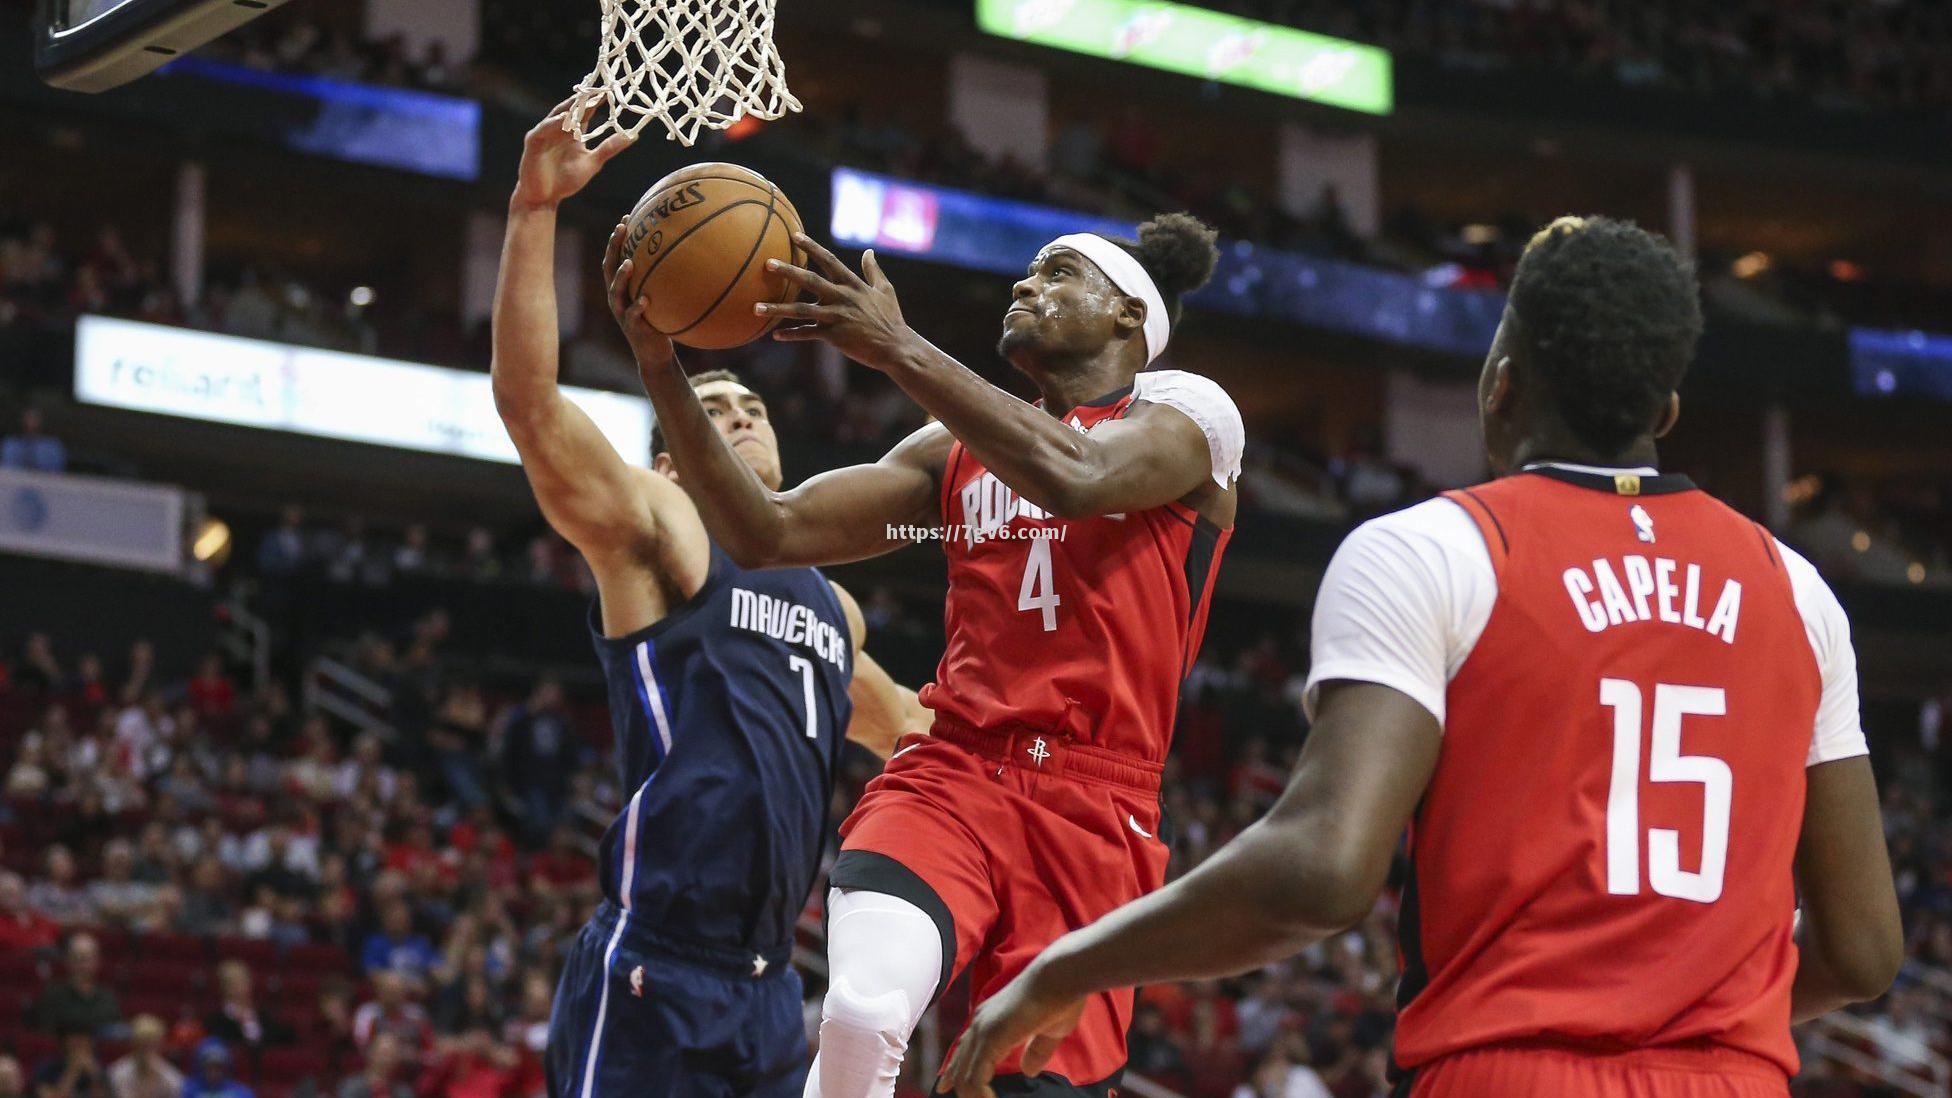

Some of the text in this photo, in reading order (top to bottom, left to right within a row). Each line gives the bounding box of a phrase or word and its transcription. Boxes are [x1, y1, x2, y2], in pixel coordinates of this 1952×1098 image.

[622, 182, 706, 258] SPALDIN
[1018, 531, 1061, 632] 4
[1563, 555, 1742, 644] CAPELA
[730, 587, 846, 673] MAVERCKS
[789, 654, 818, 739] 7
[1600, 678, 1733, 904] 15
